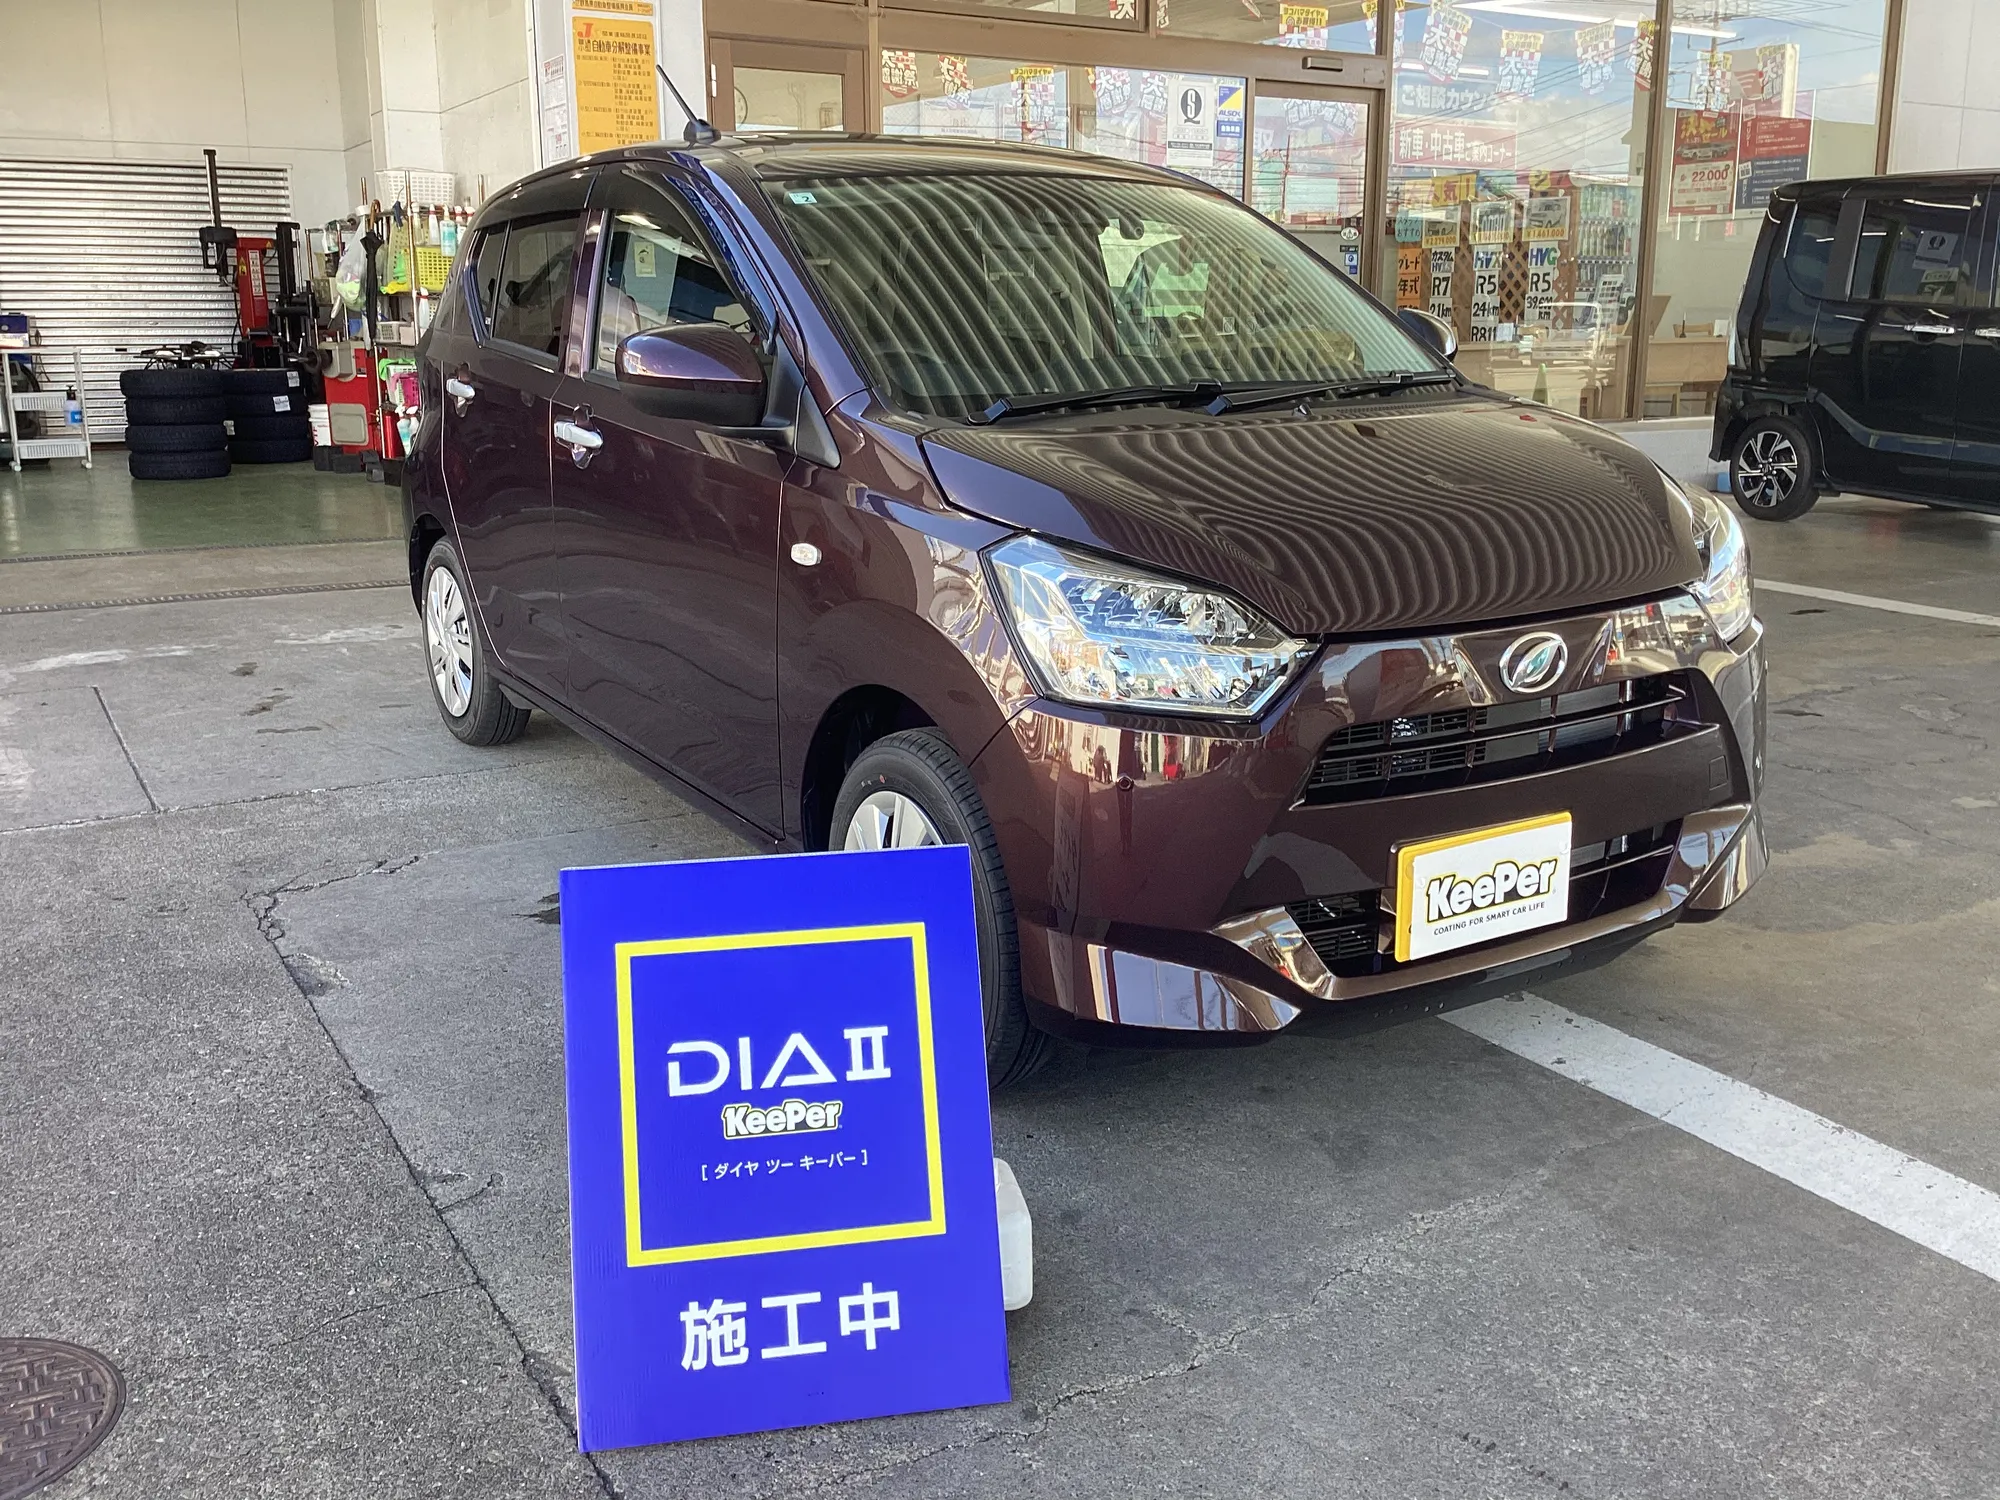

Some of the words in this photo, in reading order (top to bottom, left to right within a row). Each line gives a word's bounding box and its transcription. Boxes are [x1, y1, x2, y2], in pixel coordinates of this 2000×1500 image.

[1530, 247, 1557, 266] HVG
[1398, 276, 1420, 296] 年式
[1432, 276, 1451, 296] R7
[1476, 275, 1497, 295] R5
[1530, 272, 1551, 293] R5
[1426, 858, 1558, 923] KeePer
[1433, 921, 1466, 936] COATING
[1469, 917, 1484, 927] FOR
[1486, 910, 1510, 923] SMART
[1512, 906, 1527, 916] CAR
[1529, 901, 1545, 912] LIFE
[722, 1099, 842, 1138] KeePer
[679, 1281, 901, 1372] 施工中
